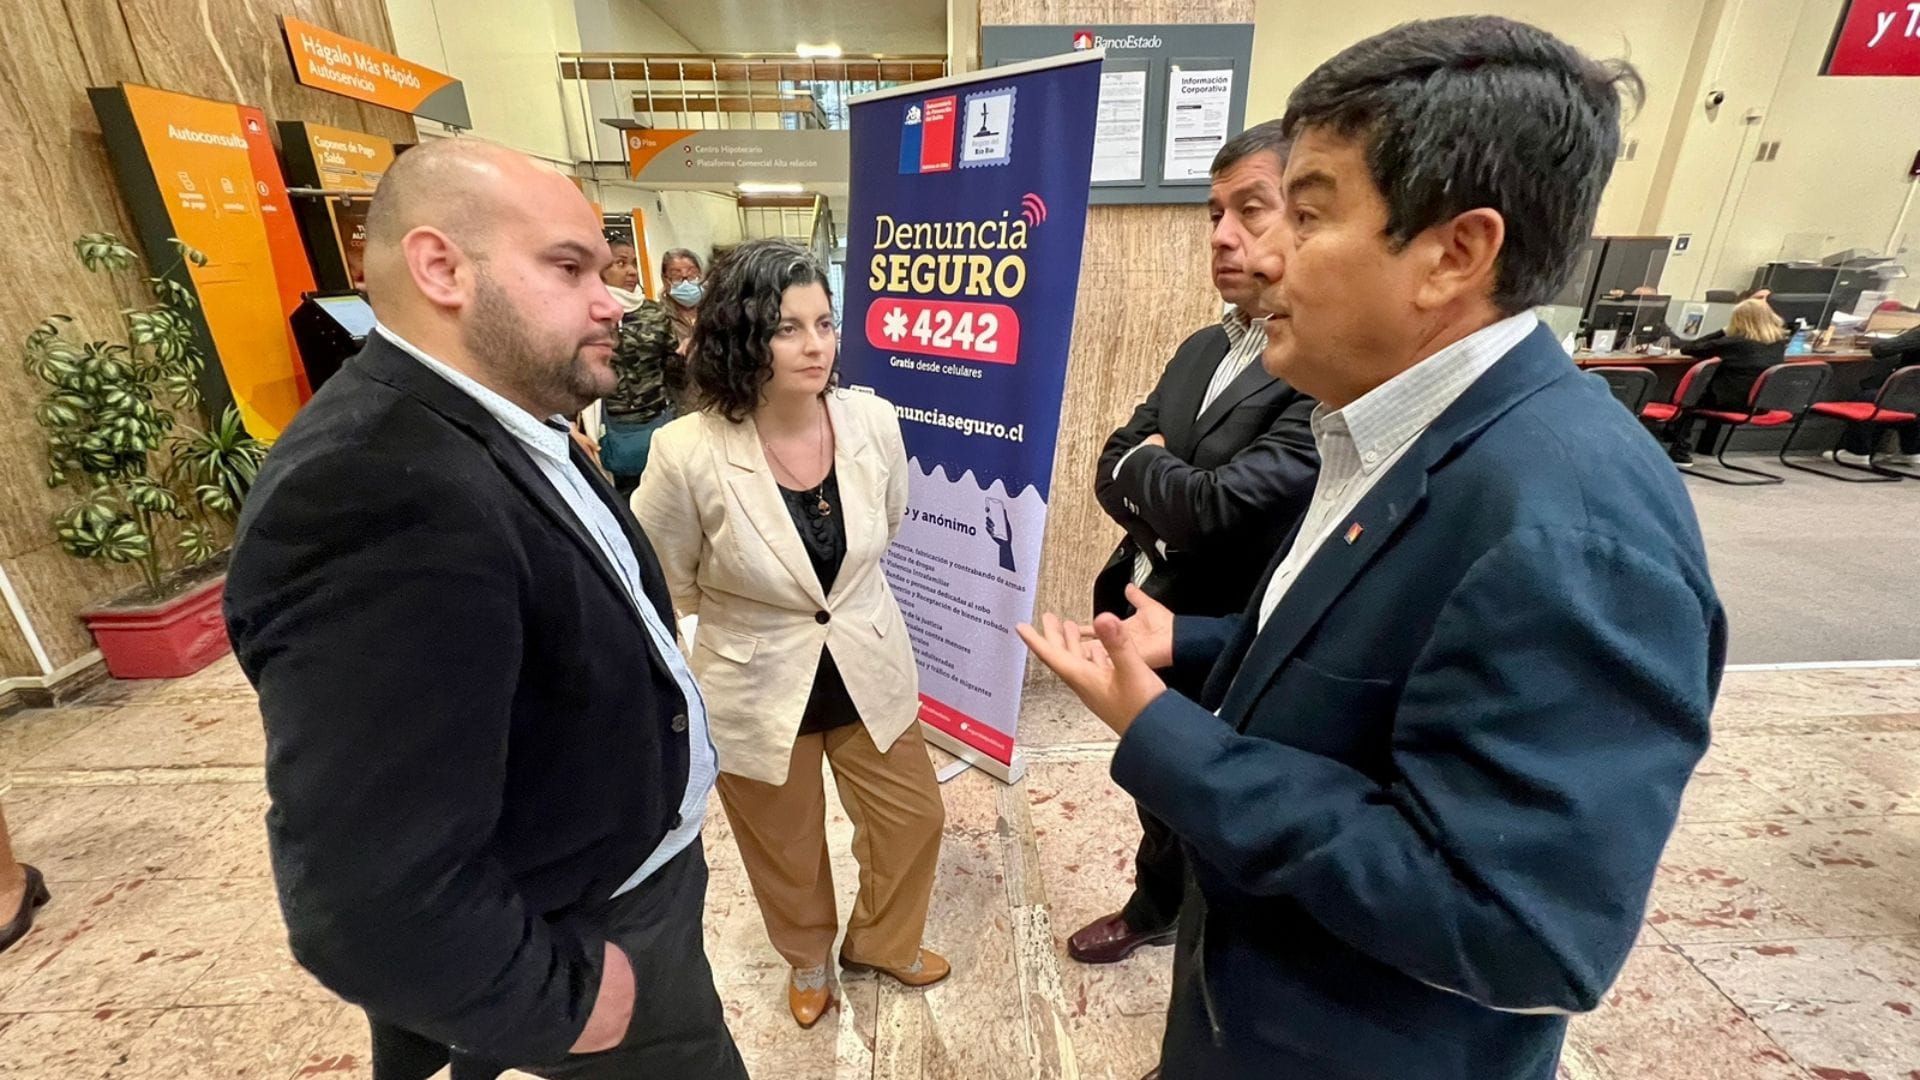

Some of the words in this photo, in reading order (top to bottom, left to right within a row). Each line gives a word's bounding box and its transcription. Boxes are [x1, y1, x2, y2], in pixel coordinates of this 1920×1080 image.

[1867, 12, 1896, 48] y
[1904, 3, 1920, 37] T
[1094, 34, 1162, 49] BancoEstado
[300, 33, 351, 66] Hágalo
[353, 52, 381, 77] Más
[382, 62, 421, 89] Rápido
[309, 60, 375, 93] Autoservicio
[1181, 76, 1228, 85] Información
[1181, 85, 1227, 97] Corporativa
[168, 123, 248, 149] Autoconsulta
[313, 135, 347, 152] Cupones
[347, 141, 357, 153] de
[357, 143, 376, 160] Pago
[323, 151, 346, 165] Saldo
[695, 145, 719, 153] Centro
[721, 145, 763, 155] Hipotecario
[697, 159, 735, 168] Plataforma
[736, 159, 771, 168] Comercial
[774, 159, 787, 168] Alta
[873, 210, 1028, 250] Denuncia
[868, 253, 1027, 298] SEGURO
[1598, 334, 1608, 348] 2
[890, 356, 914, 370] Gratis
[916, 359, 940, 373] desde
[942, 364, 983, 379] celulares
[895, 405, 1024, 443] nunciaseguro.cl
[912, 509, 920, 521] y
[922, 511, 977, 536] anónimo
[887, 559, 912, 575] Violencia
[915, 548, 948, 565] fabricación
[954, 562, 996, 582] contrabando
[996, 575, 1005, 585] de
[1005, 581, 1026, 593] armas
[937, 588, 967, 606] dedicadas
[975, 604, 991, 614] robo
[961, 609, 982, 623] bienes
[983, 617, 1009, 634] robados
[925, 630, 944, 643] contra
[945, 639, 971, 654] menores
[921, 650, 955, 669] adulteradas
[959, 678, 992, 698] migrantes
